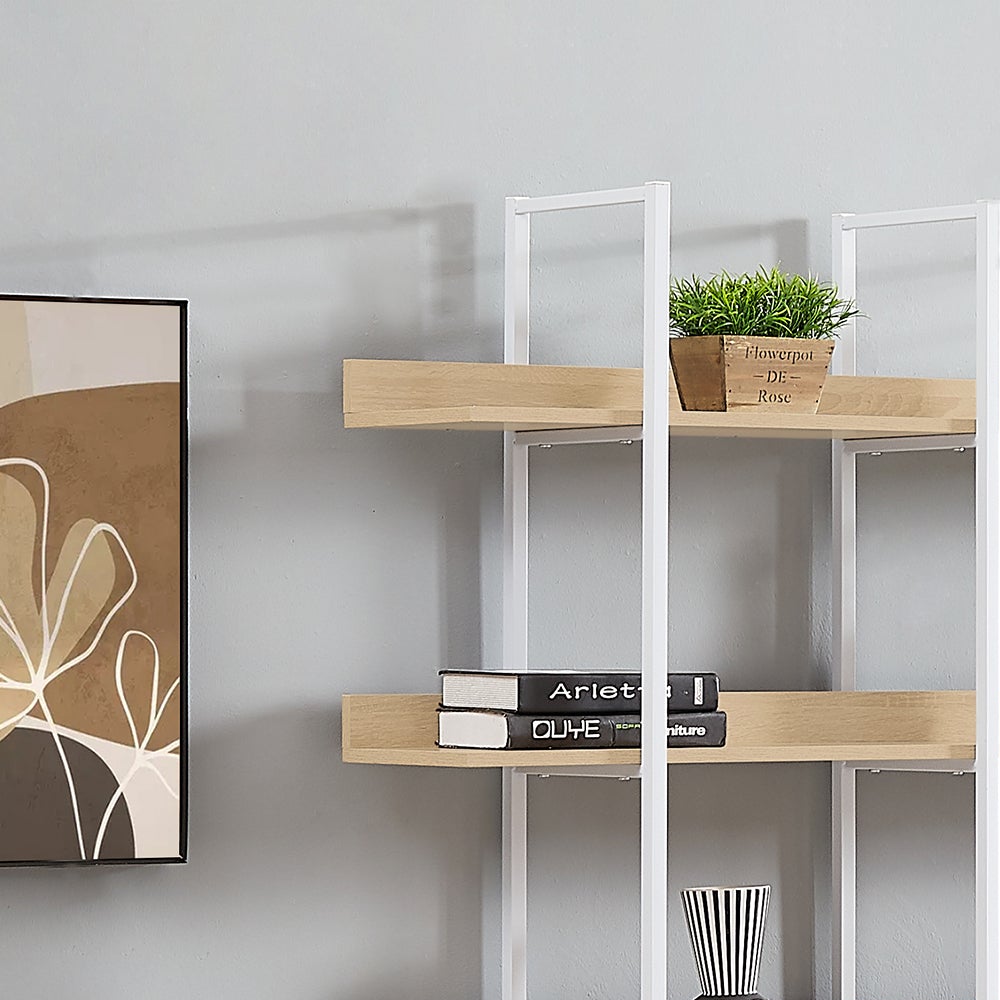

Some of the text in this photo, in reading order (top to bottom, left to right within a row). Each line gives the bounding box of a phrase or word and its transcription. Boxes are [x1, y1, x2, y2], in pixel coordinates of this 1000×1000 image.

[745, 346, 814, 365] Flowerpot
[767, 370, 787, 384] DE
[758, 389, 792, 404] Rose
